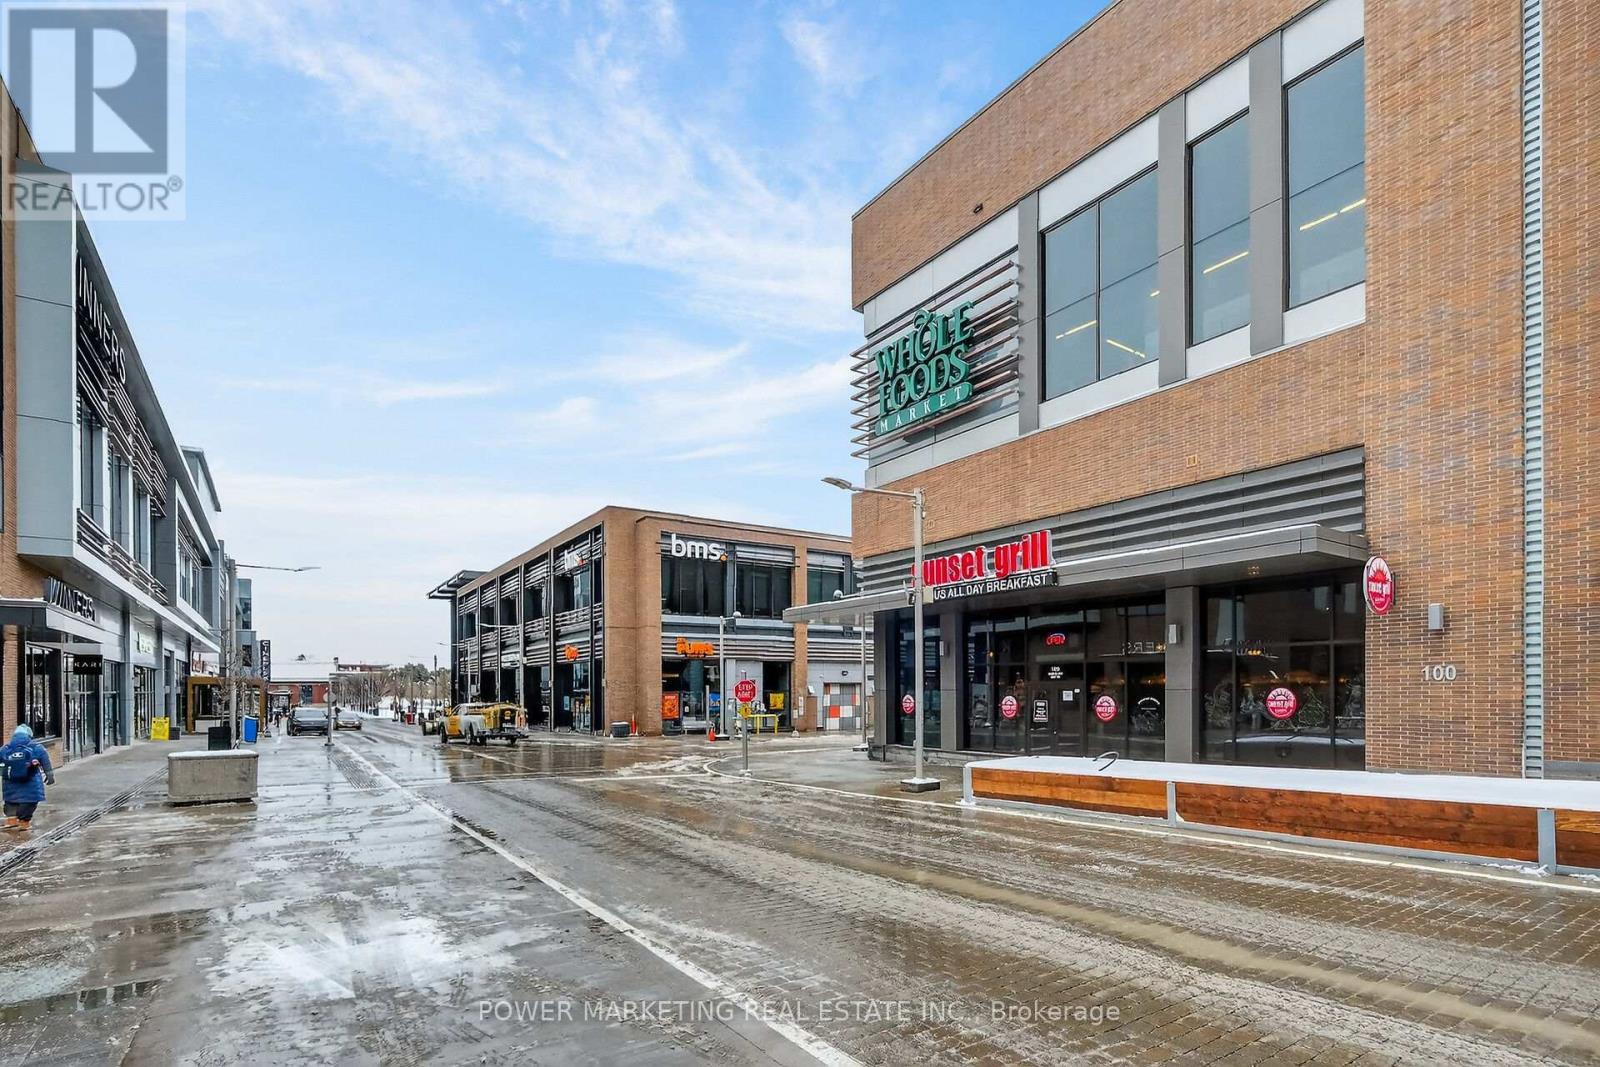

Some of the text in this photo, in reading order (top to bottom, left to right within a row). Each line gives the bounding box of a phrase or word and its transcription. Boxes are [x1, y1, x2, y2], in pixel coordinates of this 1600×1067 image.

[78, 256, 126, 385] INNERS
[874, 300, 975, 384] WHOLE
[879, 343, 970, 416] FOODS
[880, 386, 962, 433] MARKET
[994, 529, 1053, 579] grill
[948, 586, 964, 597] ALL
[966, 583, 985, 595] DAY
[986, 574, 1048, 593] BREAKFAST
[1421, 664, 1457, 681] 100
